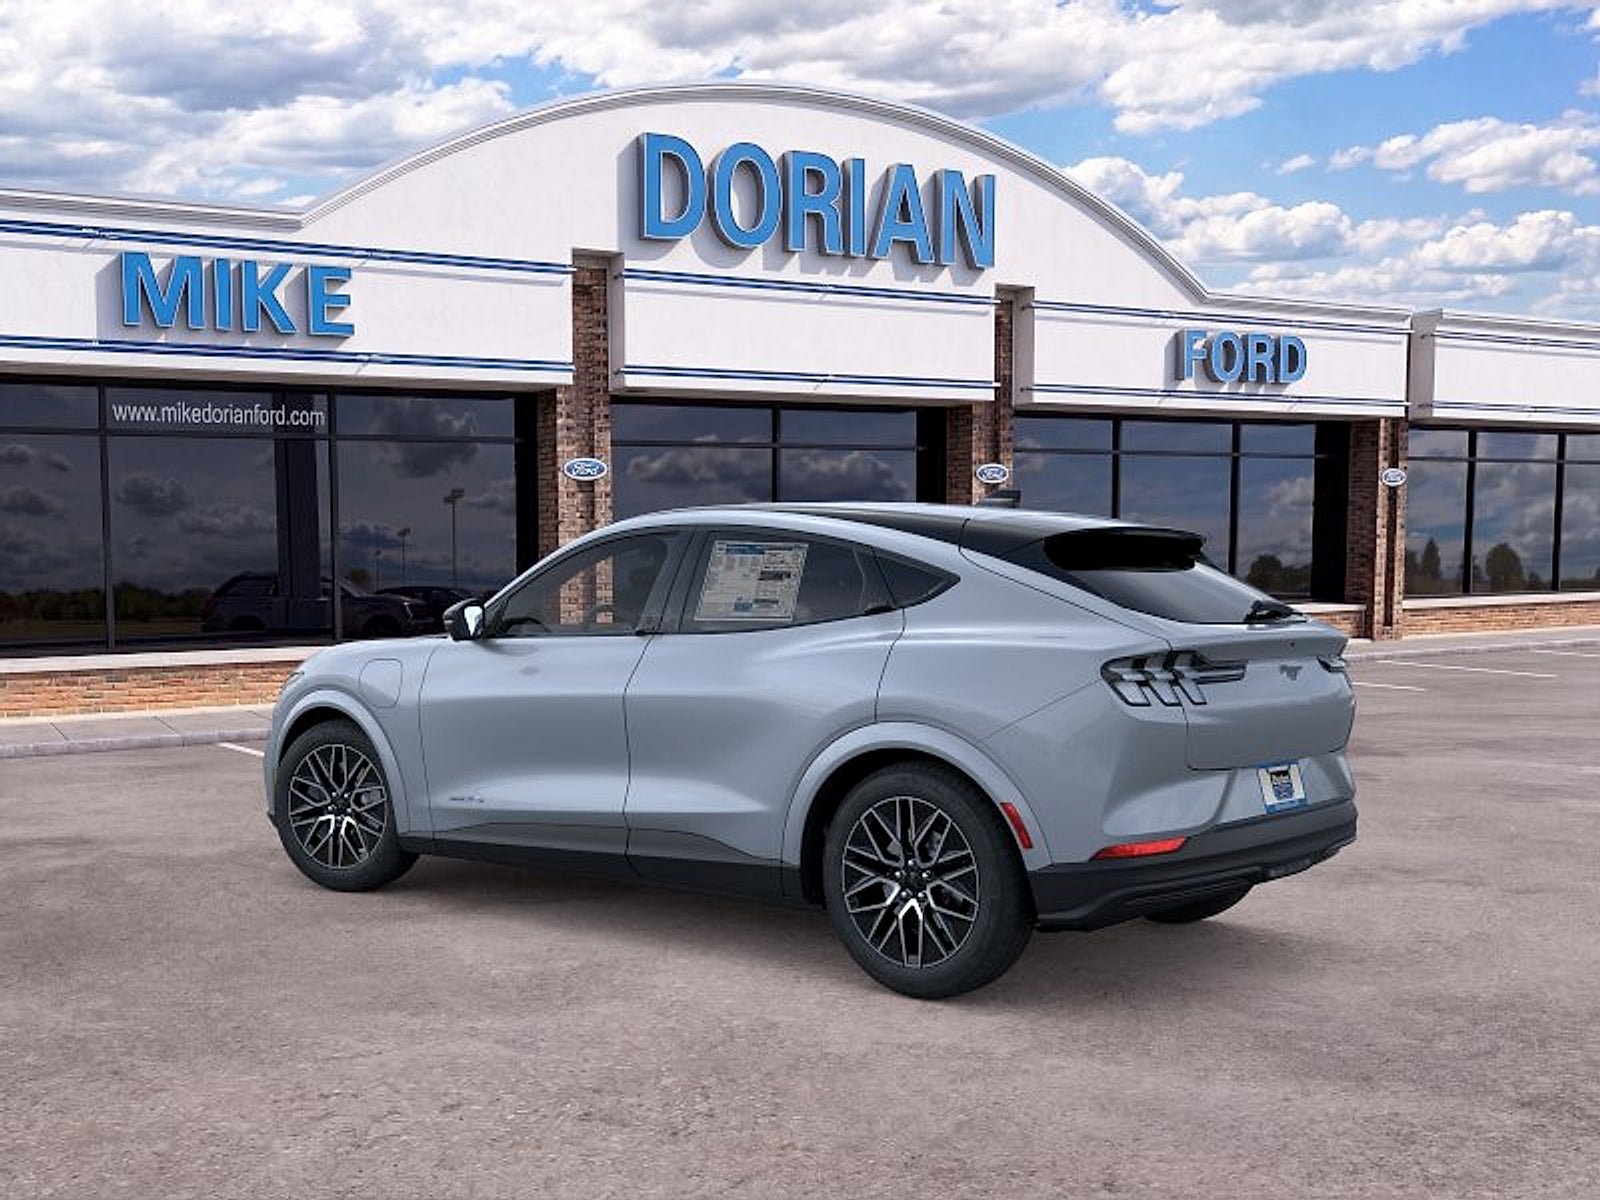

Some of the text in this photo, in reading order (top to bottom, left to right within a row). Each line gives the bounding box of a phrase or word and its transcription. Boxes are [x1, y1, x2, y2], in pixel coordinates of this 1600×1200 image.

[640, 132, 995, 268] DORIAN
[122, 251, 355, 337] MIKE
[1176, 329, 1307, 383] FORD
[112, 402, 325, 426] www.mikedorianford.com
